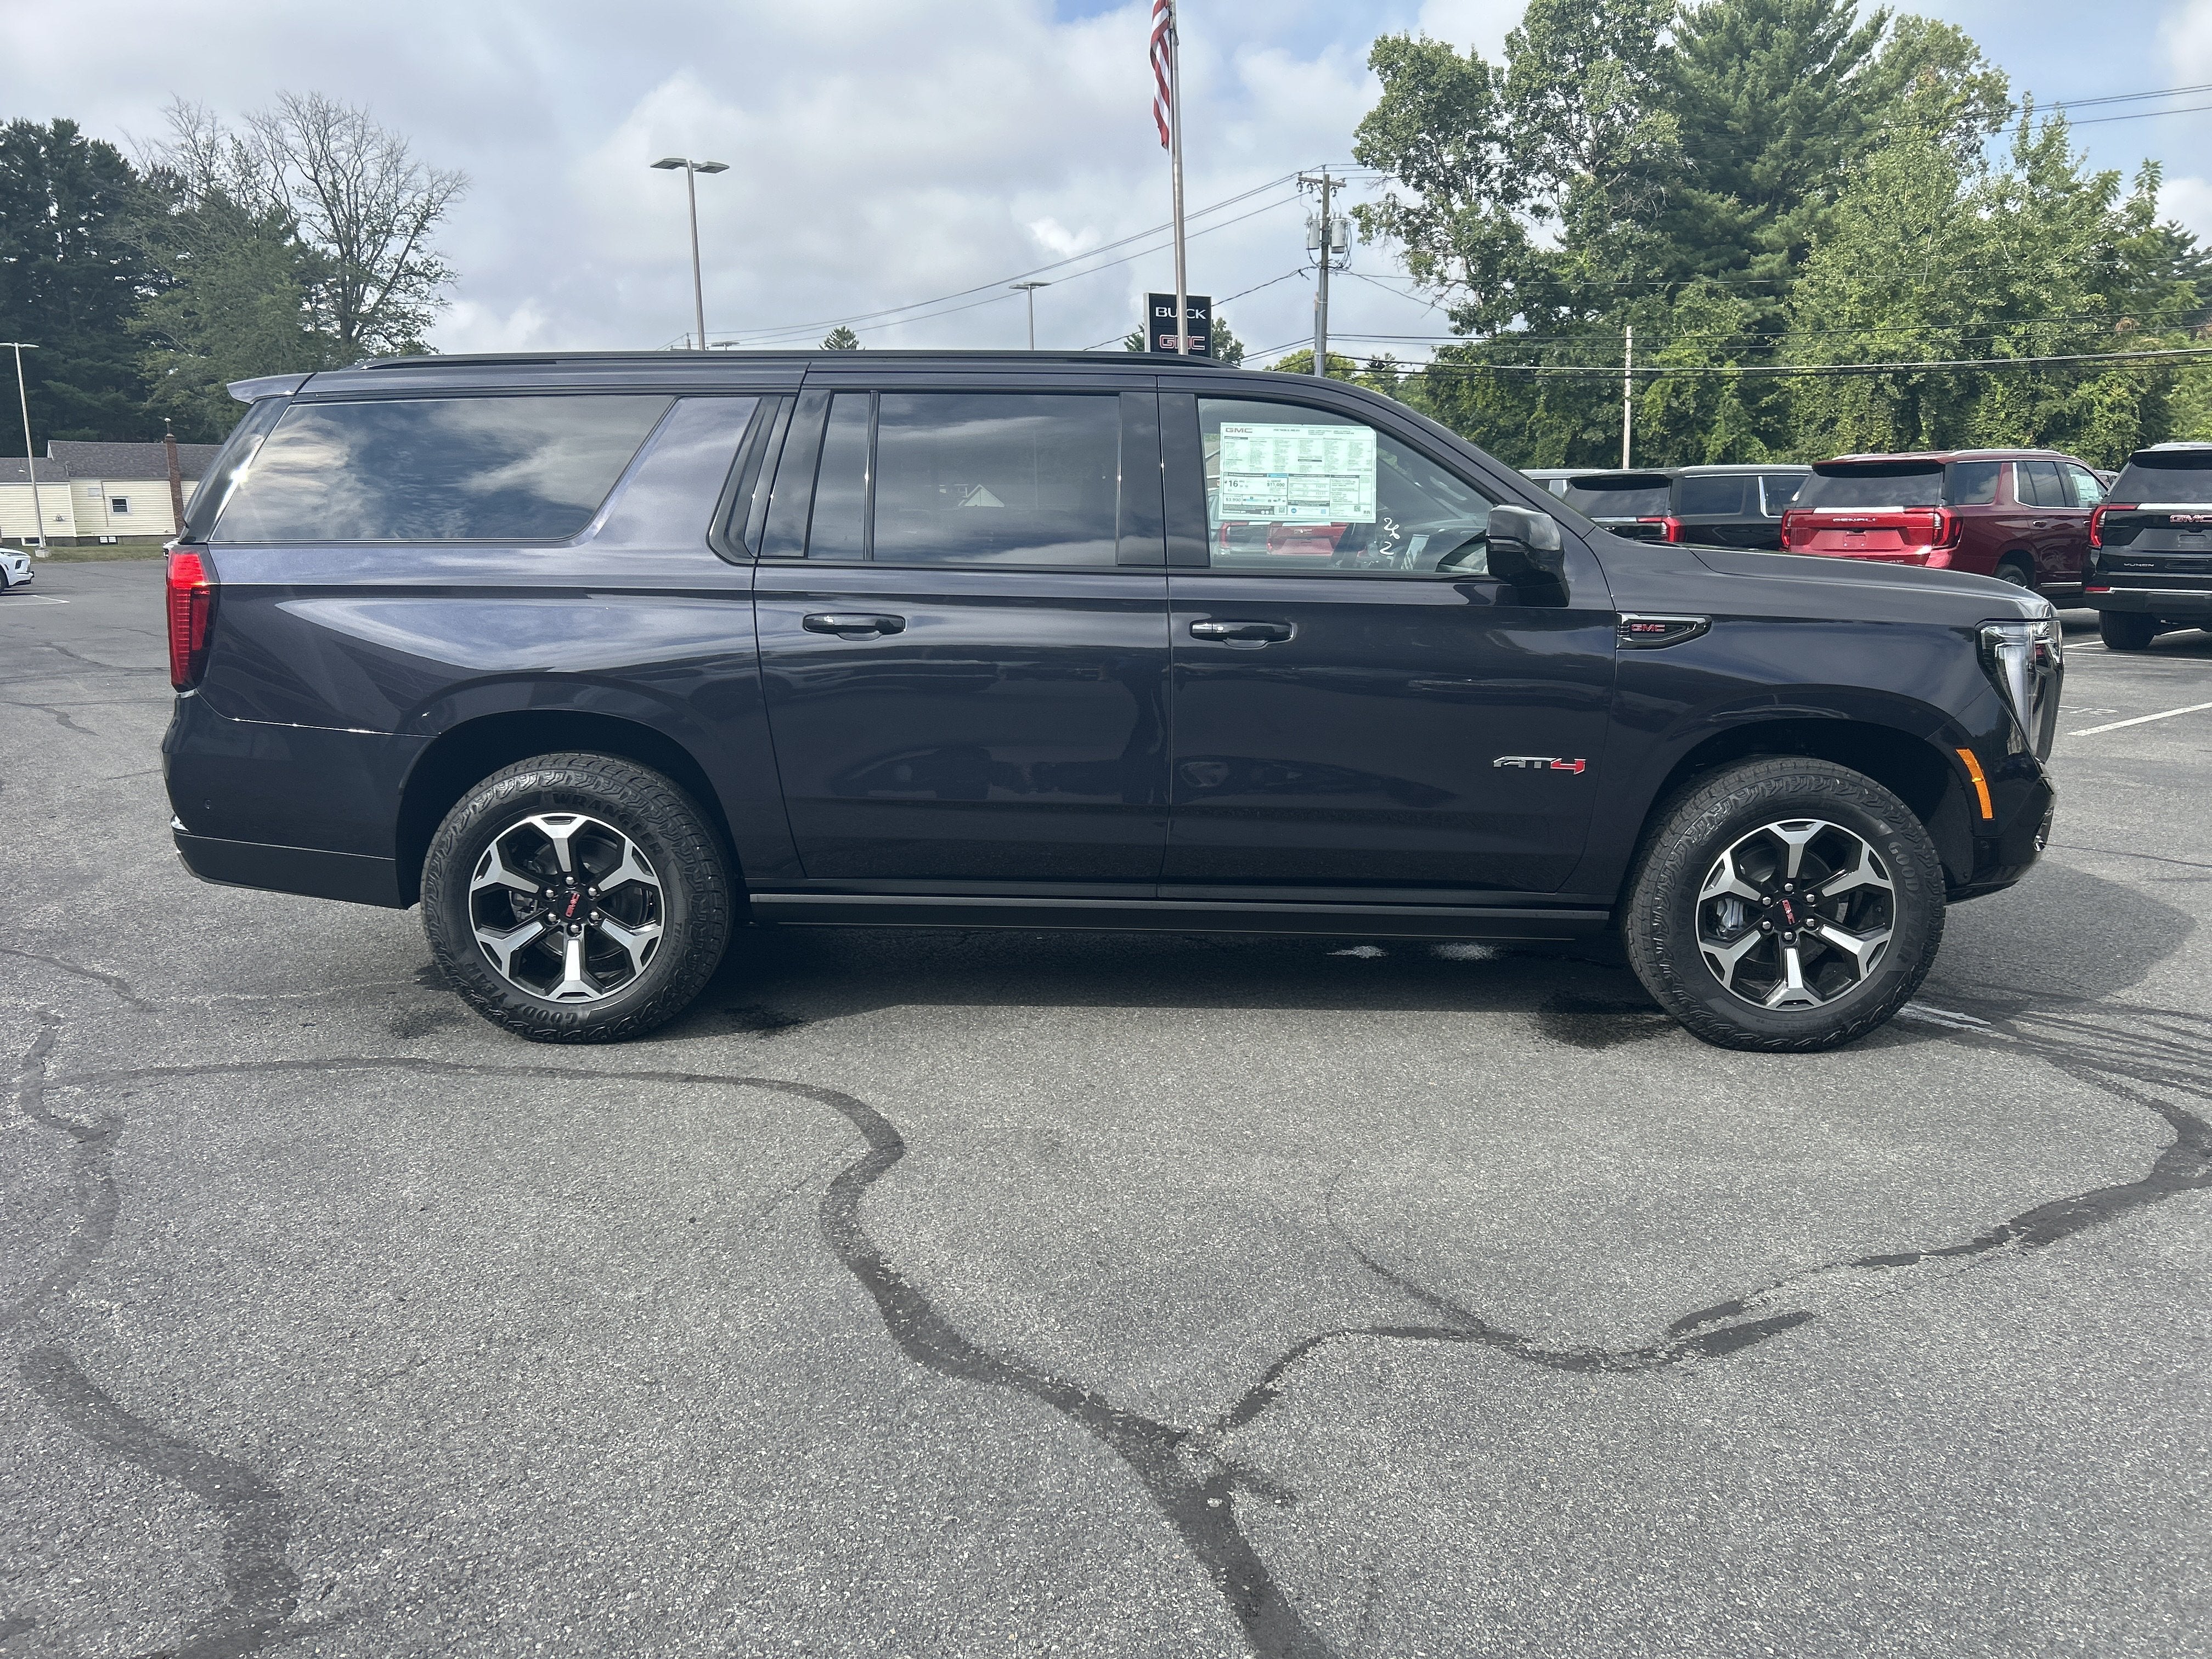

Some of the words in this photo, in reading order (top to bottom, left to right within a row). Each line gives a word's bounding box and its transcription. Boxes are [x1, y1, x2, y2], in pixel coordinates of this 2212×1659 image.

[1155, 307, 1207, 319] BUCK
[1631, 624, 1666, 632] GMC
[1493, 755, 1587, 775] AT4
[552, 792, 664, 855] WRANGLER
